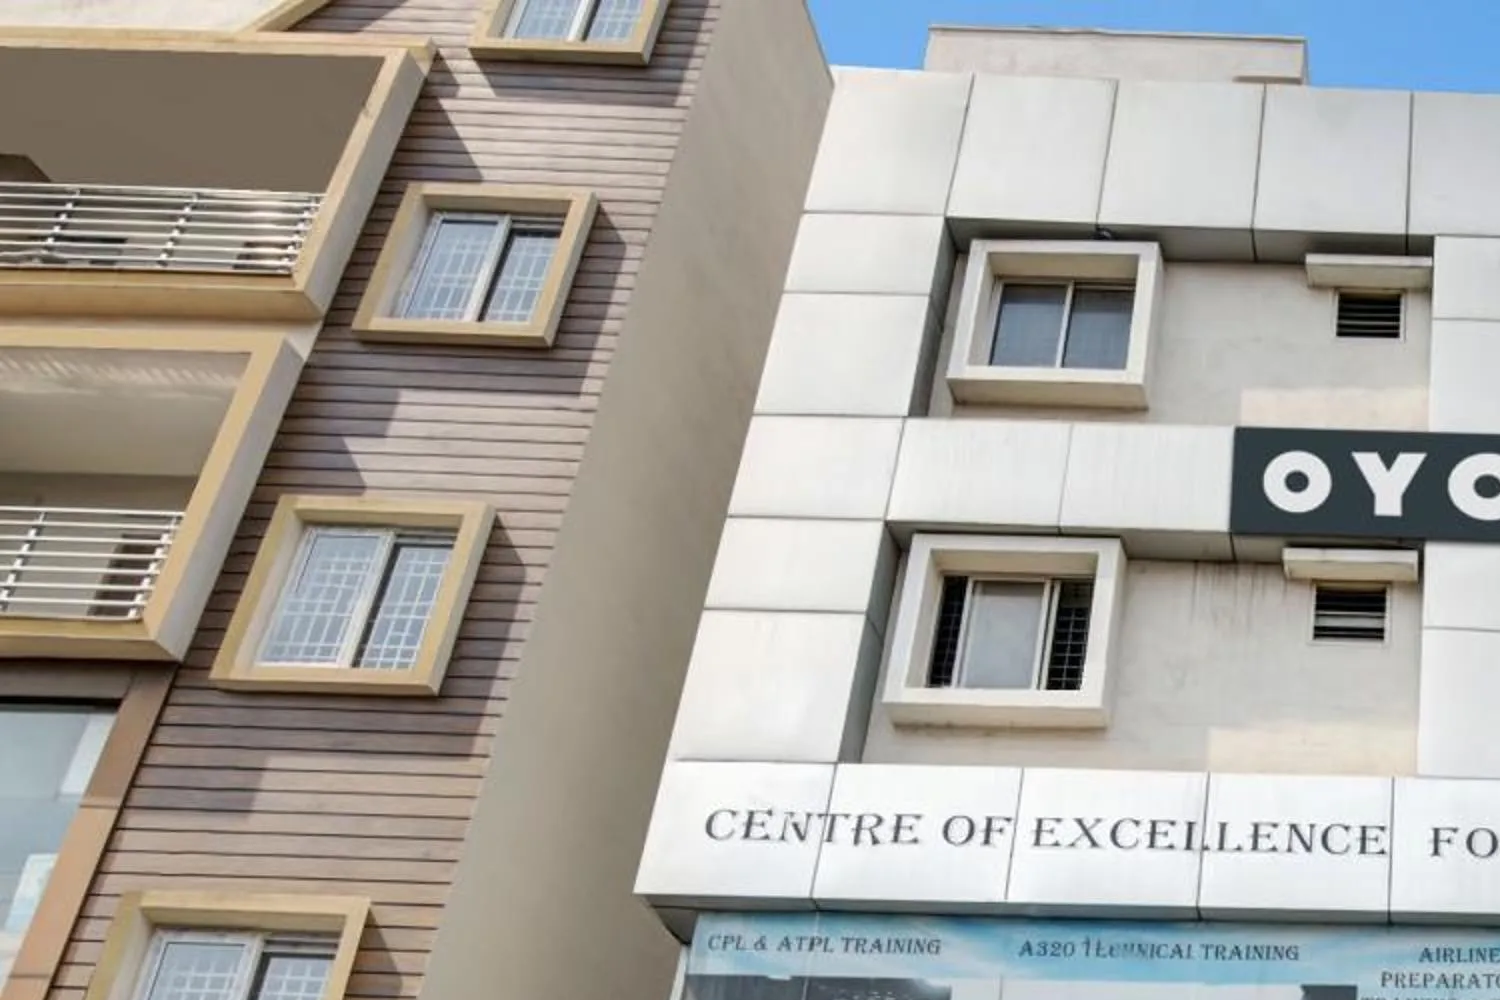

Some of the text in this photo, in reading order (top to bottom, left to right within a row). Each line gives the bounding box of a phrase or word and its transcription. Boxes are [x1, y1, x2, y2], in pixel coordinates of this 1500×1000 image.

[704, 808, 922, 848] CENTRE
[942, 814, 1015, 847] OF
[1032, 816, 1388, 857] EXCELLENCE
[707, 934, 942, 955] CPL & ATPL TRAINING
[1018, 939, 1075, 958] A320
[1199, 943, 1300, 961] TRAINING
